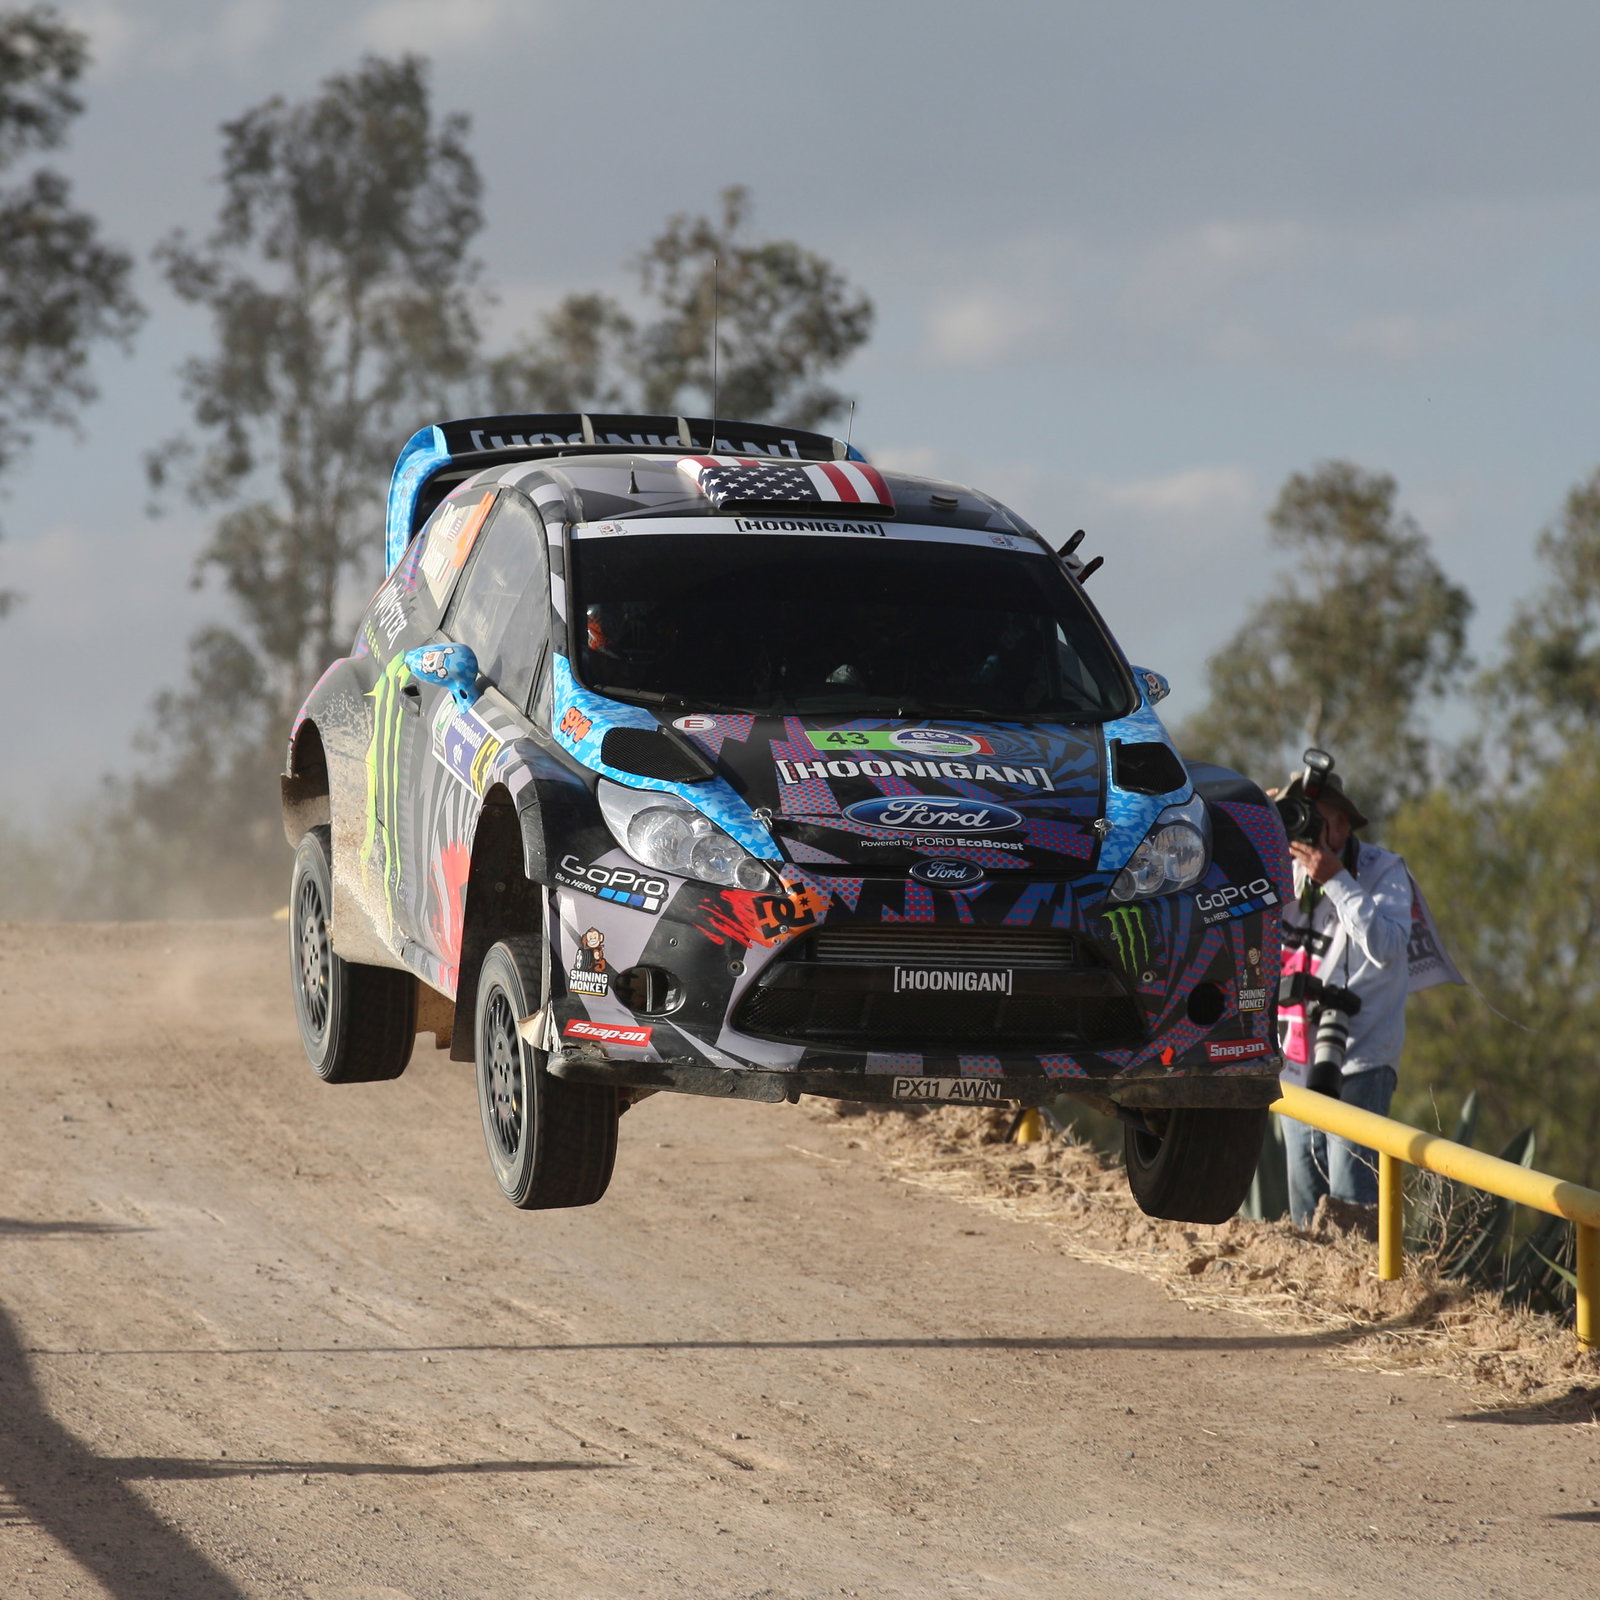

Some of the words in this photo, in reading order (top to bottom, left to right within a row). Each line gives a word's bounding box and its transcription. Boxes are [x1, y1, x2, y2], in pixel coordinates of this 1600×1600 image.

[734, 518, 885, 537] [HOONIGAN]
[684, 719, 705, 729] E
[826, 732, 870, 745] 43
[775, 759, 1055, 792] [HOONIGAN]
[879, 800, 991, 827] Ford
[860, 839, 900, 847] Powered
[901, 839, 914, 847] by
[916, 837, 955, 847] FORD
[956, 838, 1024, 850] EcoBoost
[554, 872, 564, 882] Be
[560, 855, 665, 896] GoPro
[926, 861, 967, 879] Ford
[1195, 878, 1270, 911] GoPro
[570, 969, 608, 984] SHINING
[893, 966, 1013, 995] [HOONIGAN]
[569, 980, 607, 994] MONKEY
[1239, 988, 1266, 1000] SHINING
[1239, 999, 1265, 1009] MONKEY
[568, 1022, 647, 1042] Snap-on
[1210, 1042, 1265, 1057] Snap-on
[896, 1080, 940, 1097] PX11
[948, 1081, 999, 1099] AWN
